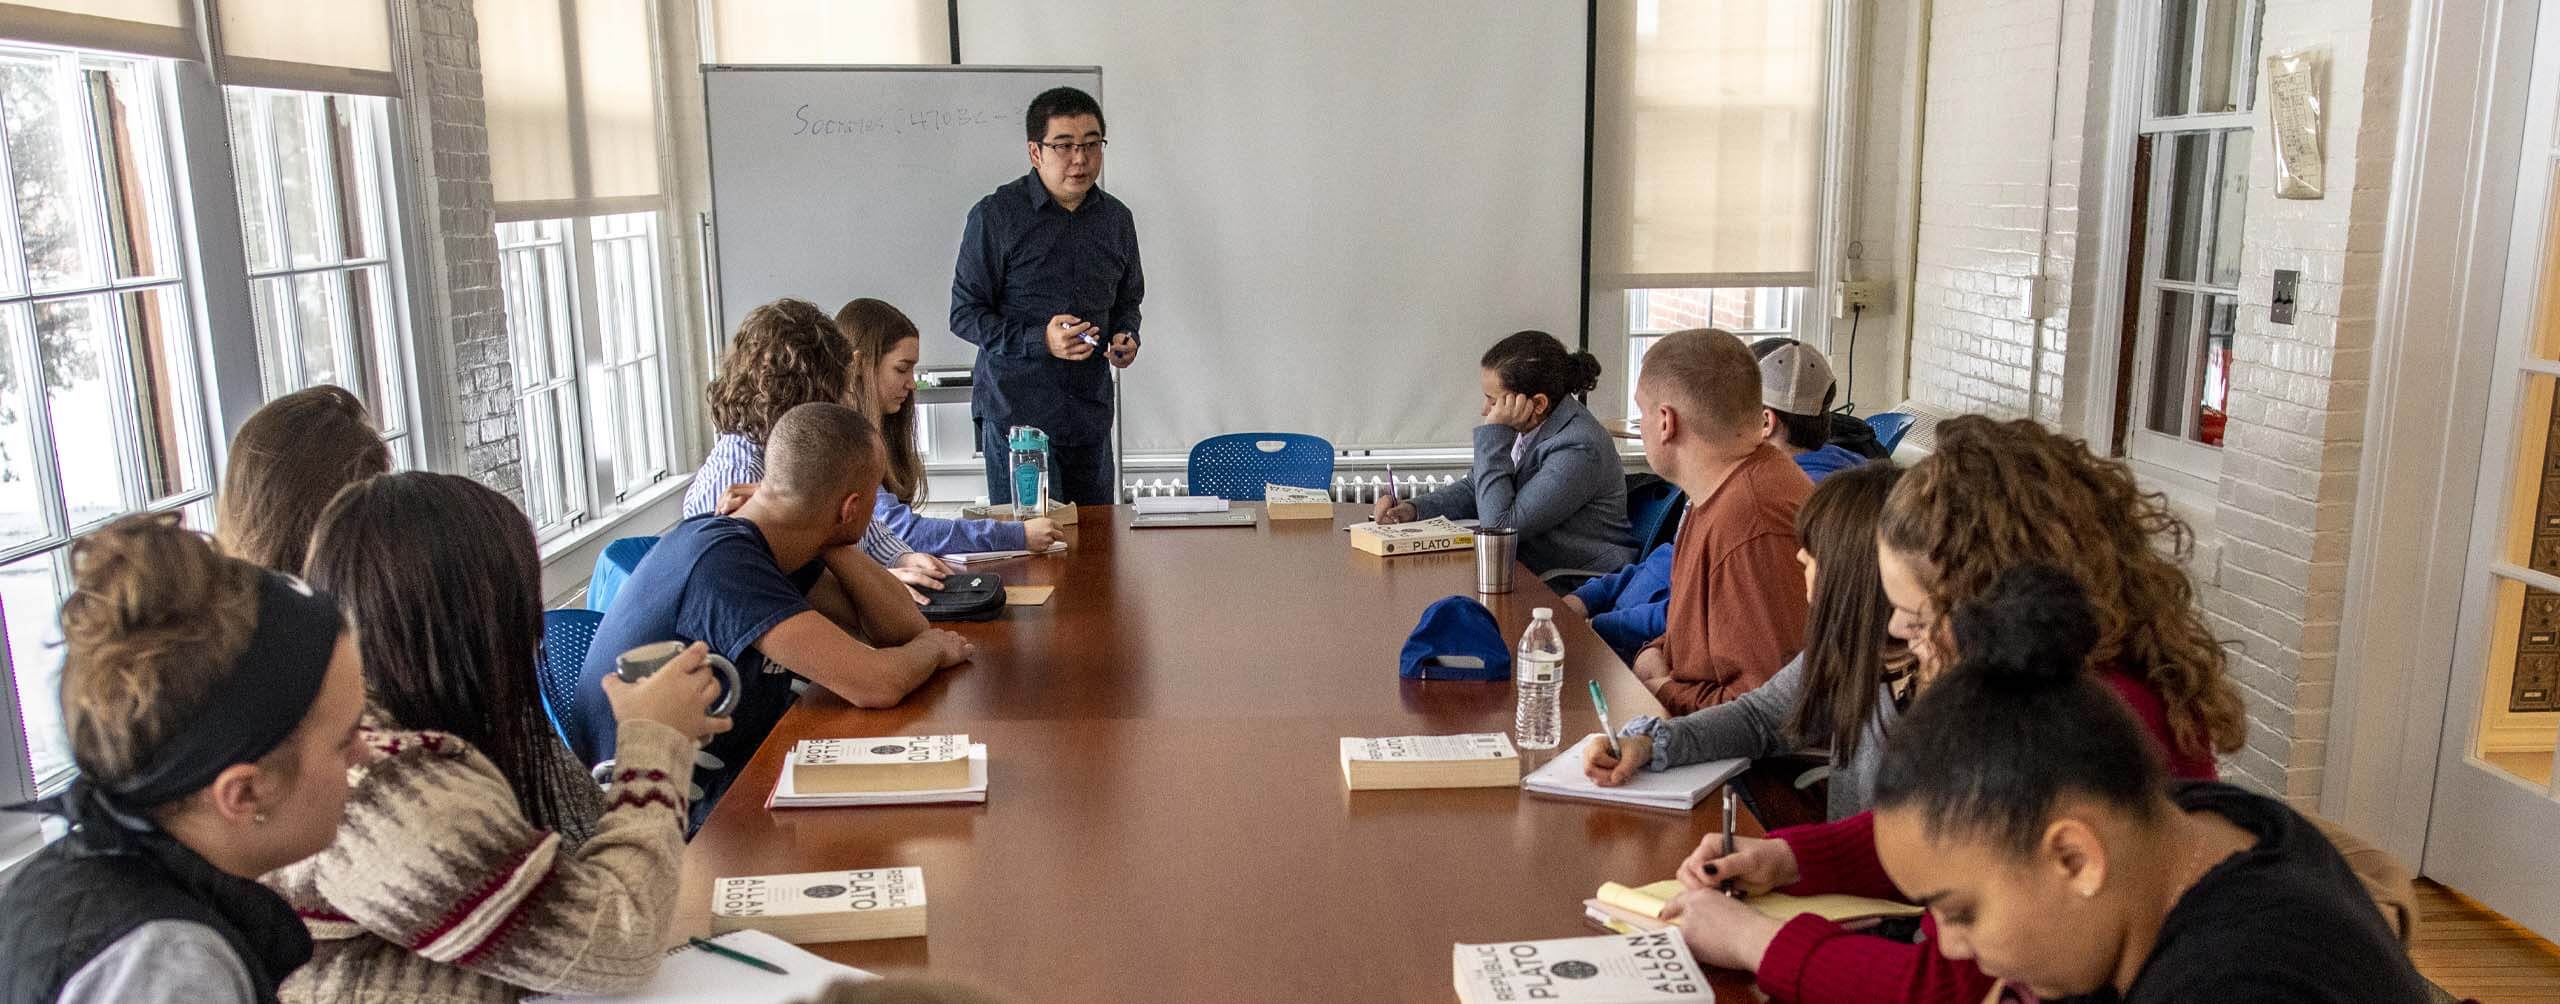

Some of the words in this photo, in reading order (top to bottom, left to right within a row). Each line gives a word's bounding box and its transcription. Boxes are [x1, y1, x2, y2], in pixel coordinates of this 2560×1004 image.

[1412, 538, 1451, 551] PLATO
[724, 879, 745, 917] BLOOM
[745, 879, 766, 916] ALLAN
[849, 871, 878, 910] PLATO
[1477, 946, 1517, 1002] REPUBLIC
[1510, 944, 1560, 999] PLATO
[1626, 935, 1675, 994] ALLAN
[1648, 932, 1698, 994] BLOOM
